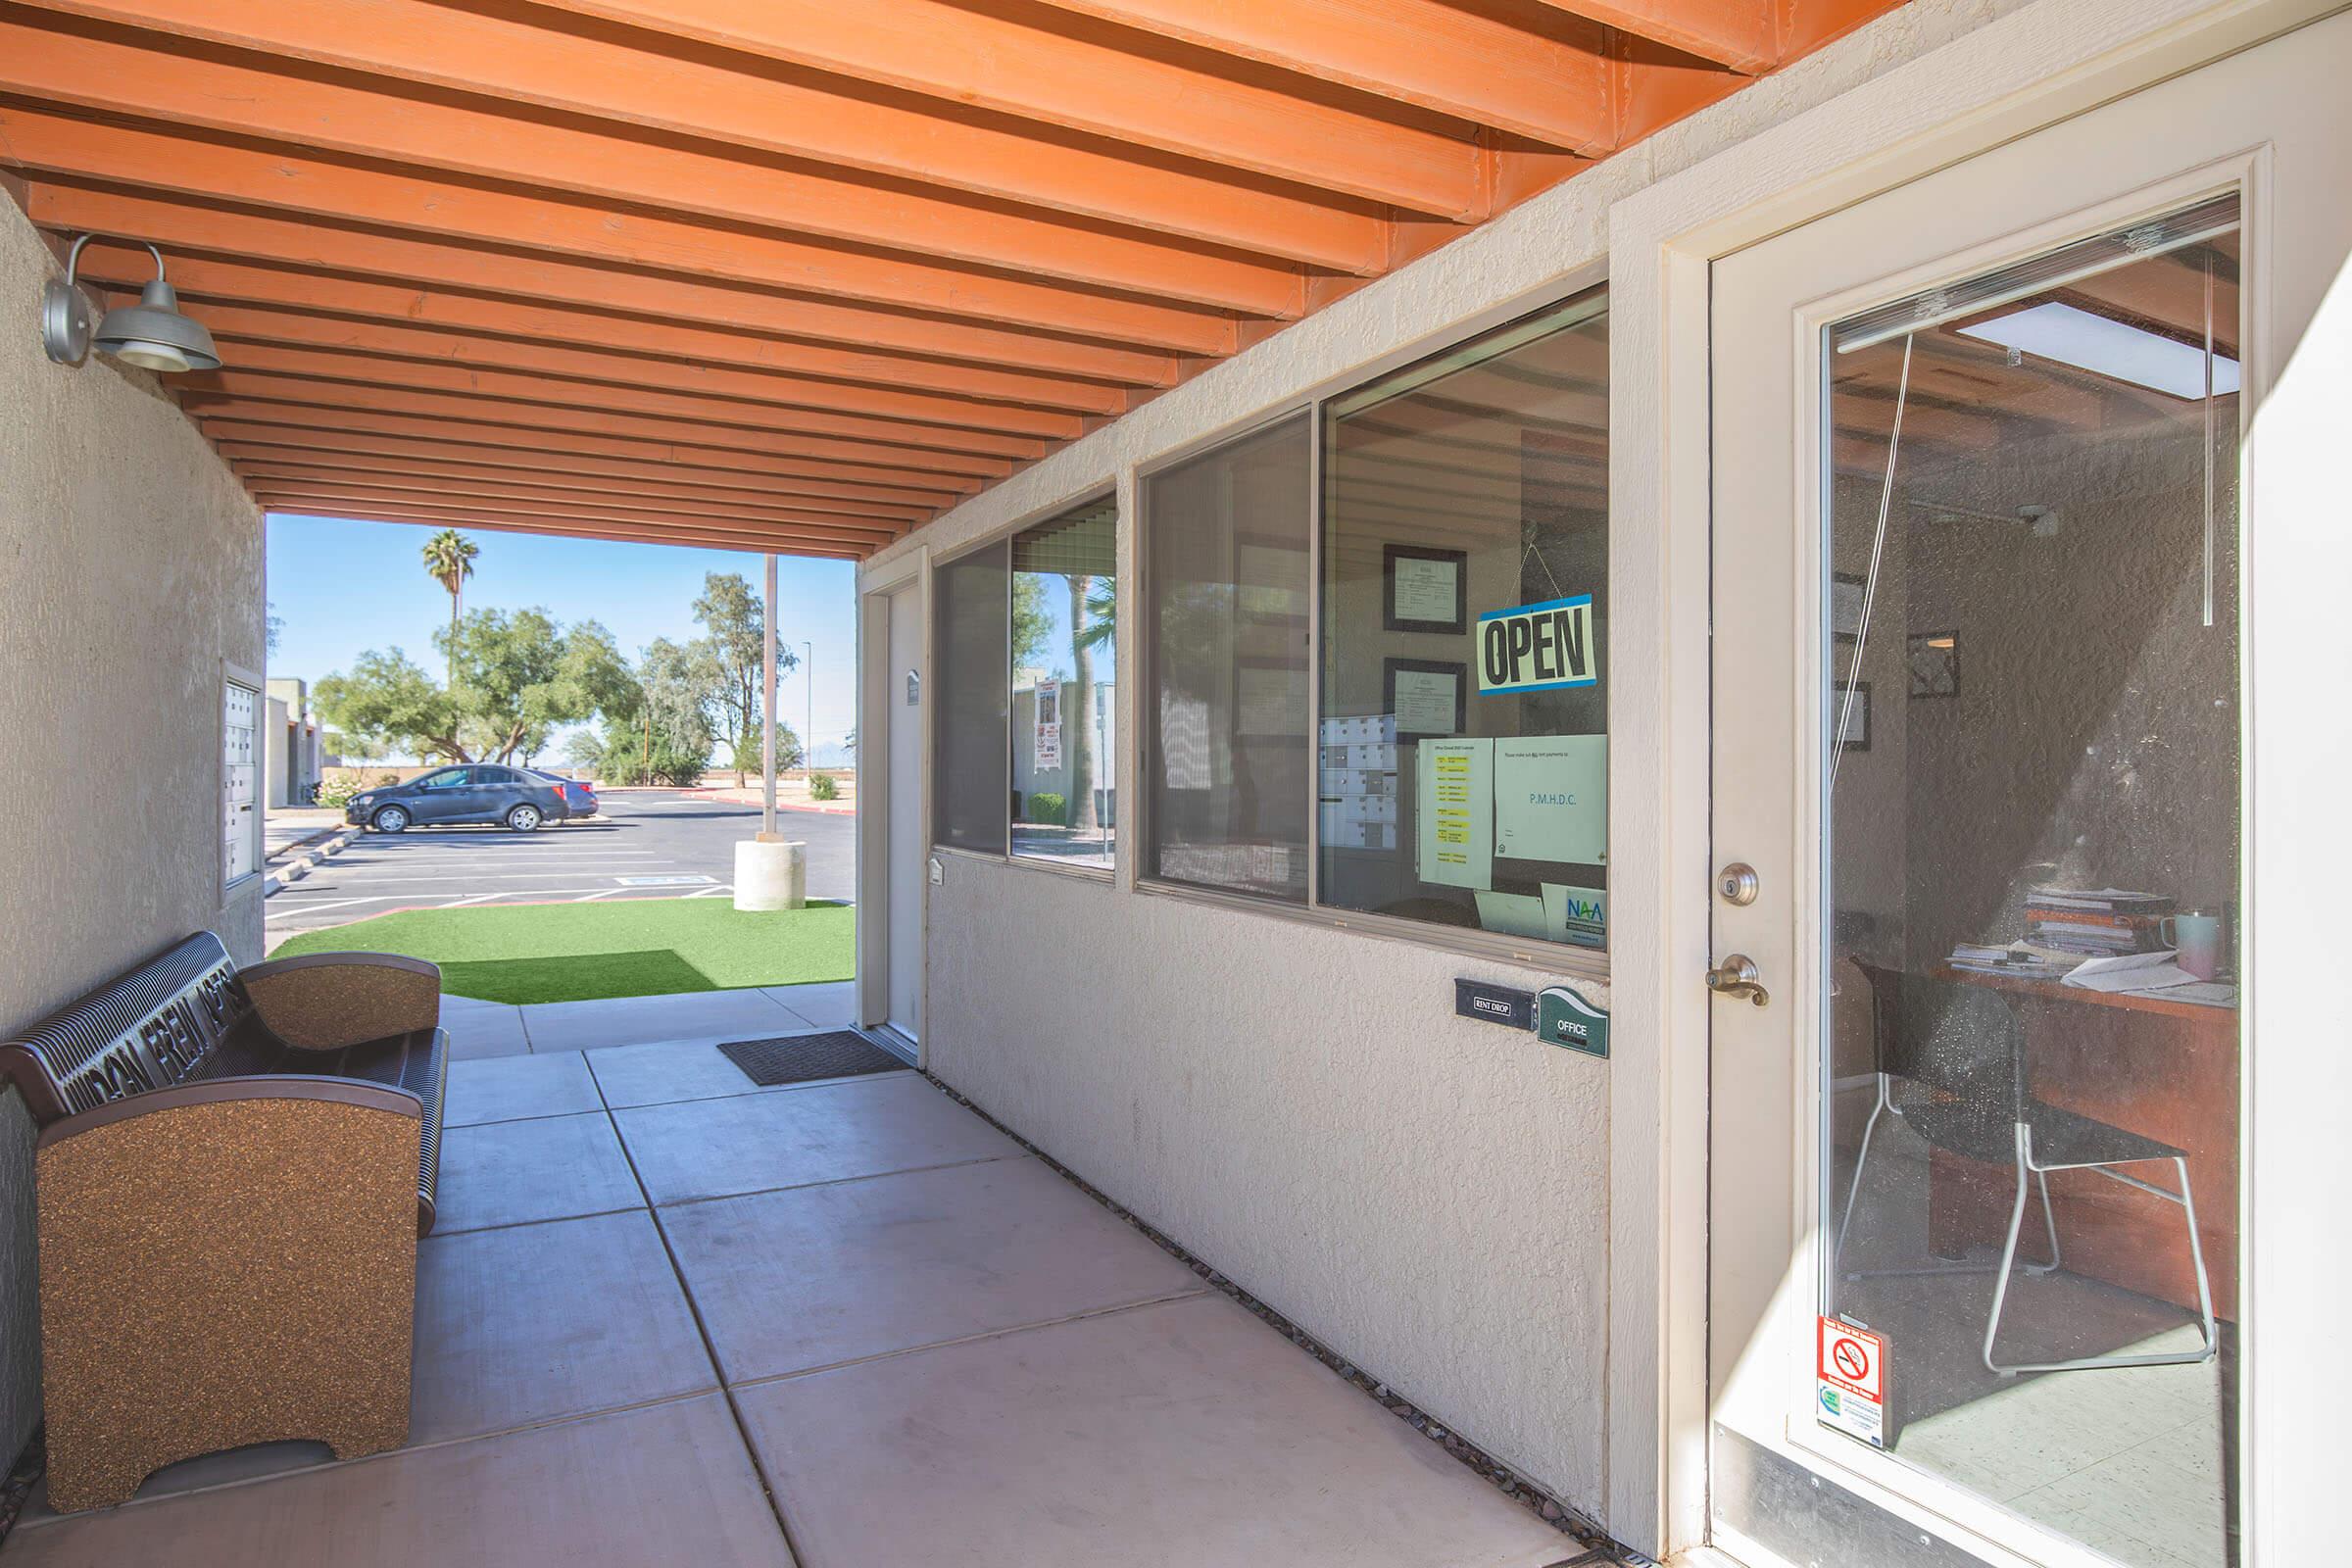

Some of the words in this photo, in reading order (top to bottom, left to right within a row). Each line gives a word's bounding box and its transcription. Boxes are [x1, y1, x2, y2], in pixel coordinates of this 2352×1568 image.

[1485, 608, 1586, 685] OPEN
[1530, 793, 1577, 806] P.M.H.D.C.
[1568, 899, 1603, 921] NAA
[1476, 1000, 1491, 1010] RENT
[1491, 1003, 1509, 1013] DROP
[1557, 1019, 1588, 1036] OFFICE
